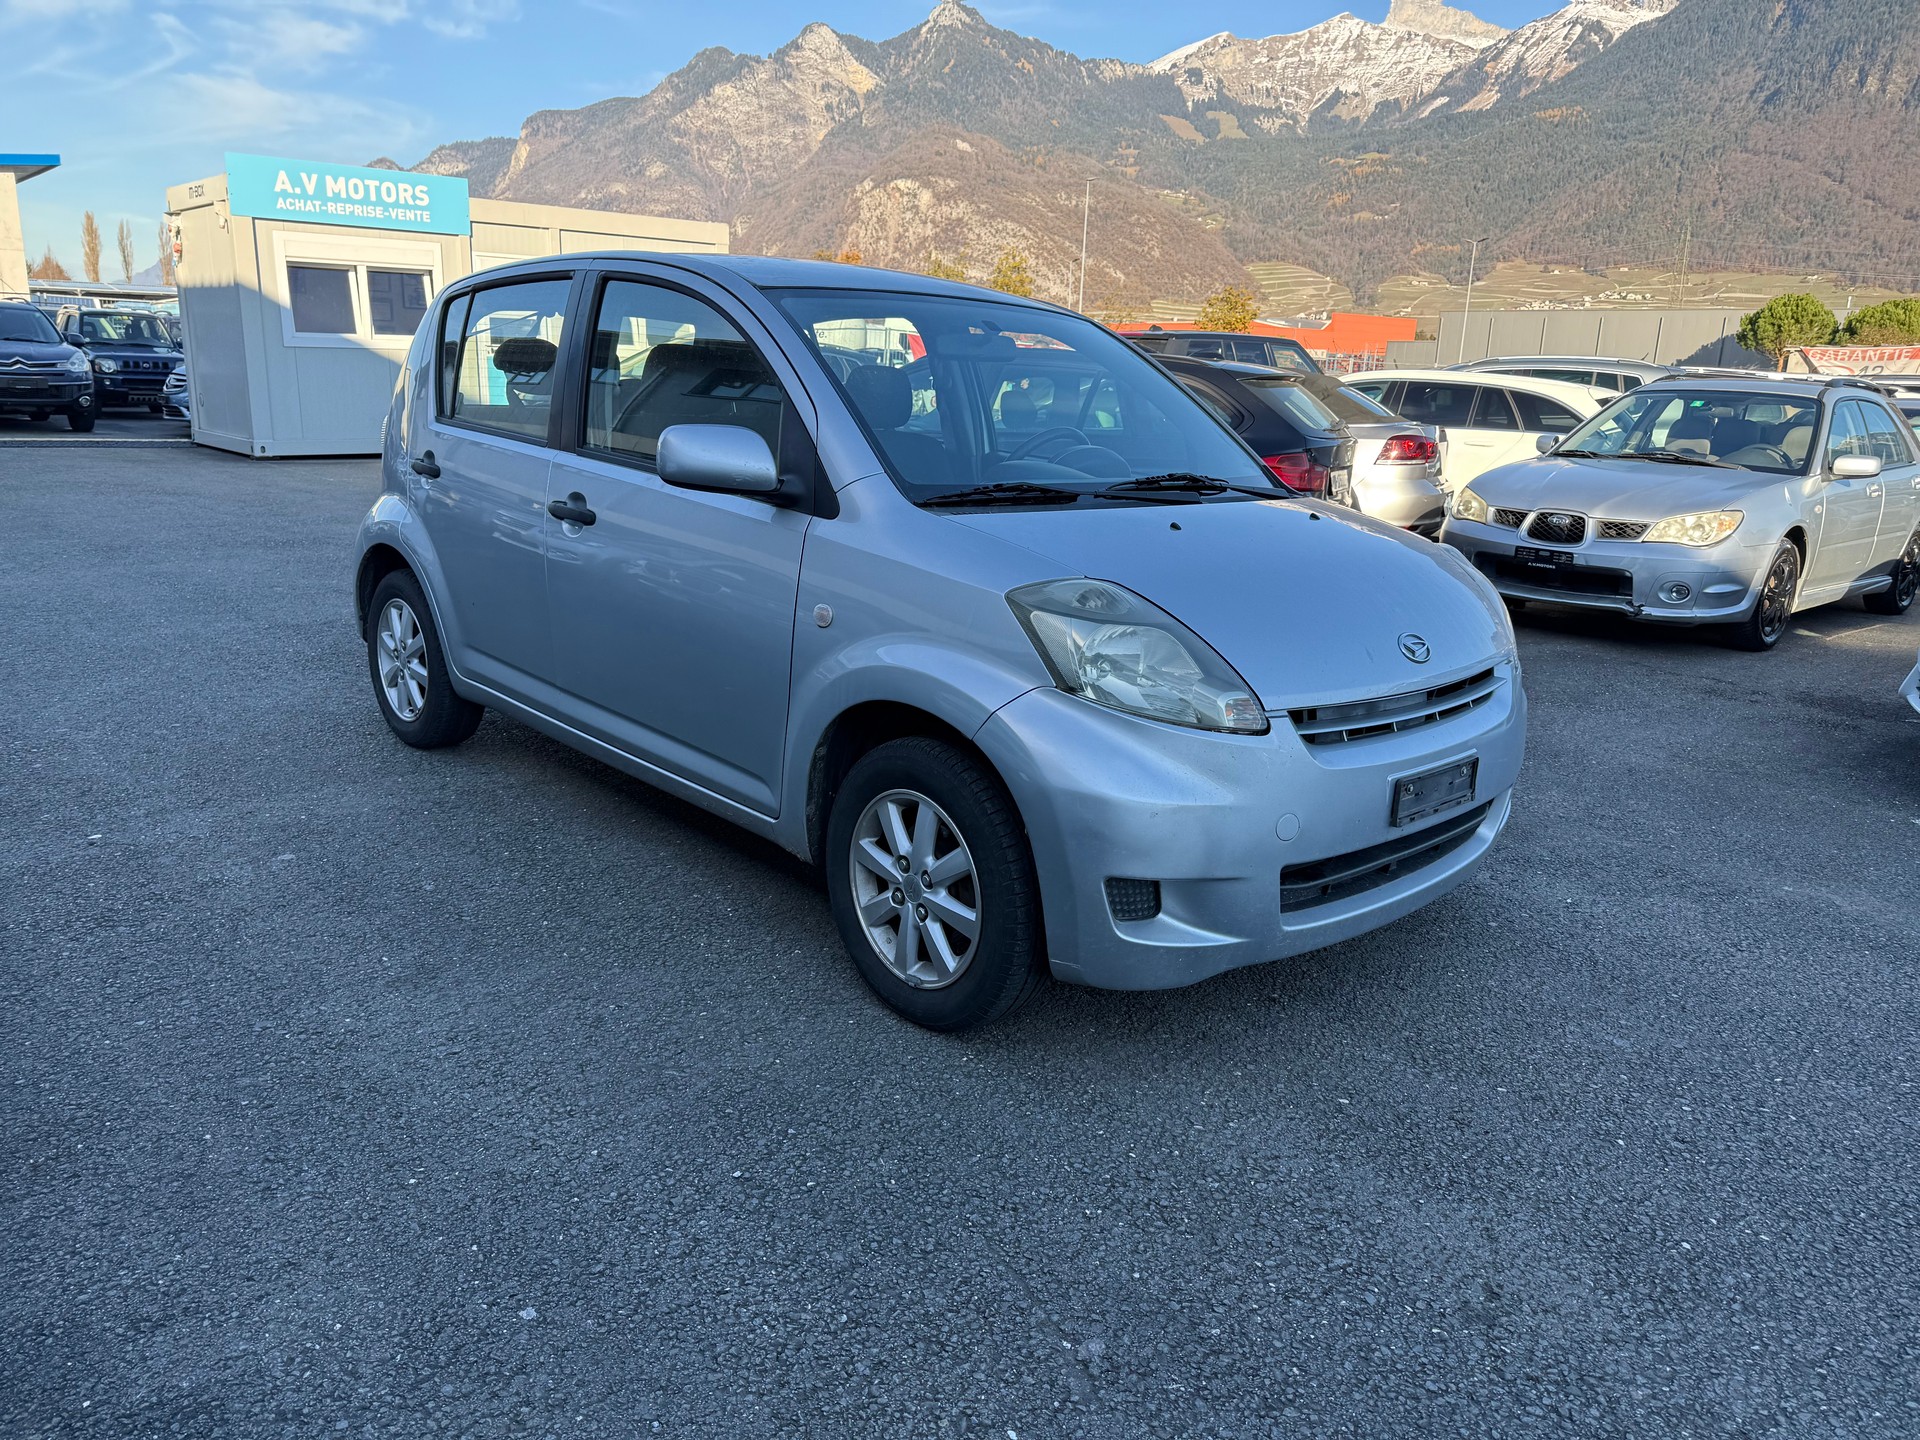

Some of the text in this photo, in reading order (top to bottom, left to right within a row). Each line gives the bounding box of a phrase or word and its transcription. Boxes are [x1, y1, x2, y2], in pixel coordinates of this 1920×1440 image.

[274, 170, 430, 207] A.V MOTORS
[276, 197, 431, 223] ACHAT-REPRISE-VENTE
[1808, 348, 1914, 362] GARANTIE
